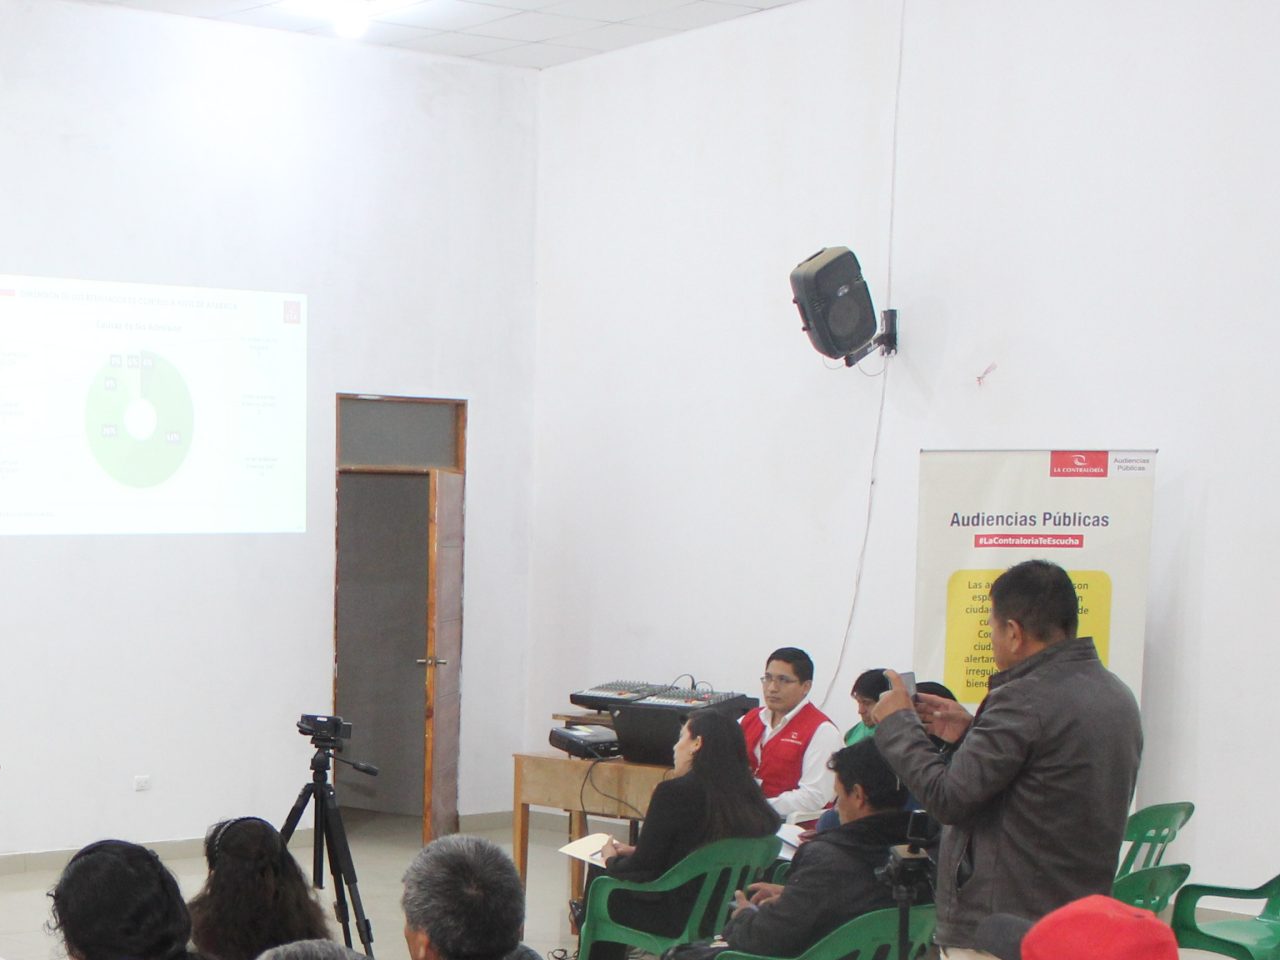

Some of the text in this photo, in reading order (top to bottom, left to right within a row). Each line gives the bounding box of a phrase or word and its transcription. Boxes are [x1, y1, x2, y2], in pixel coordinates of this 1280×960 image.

[950, 512, 1109, 526] Audiencias Públicas
[979, 537, 1079, 545] #LaContraloriaTeEscucha
[968, 581, 982, 589] Las
[966, 668, 998, 677] irregula
